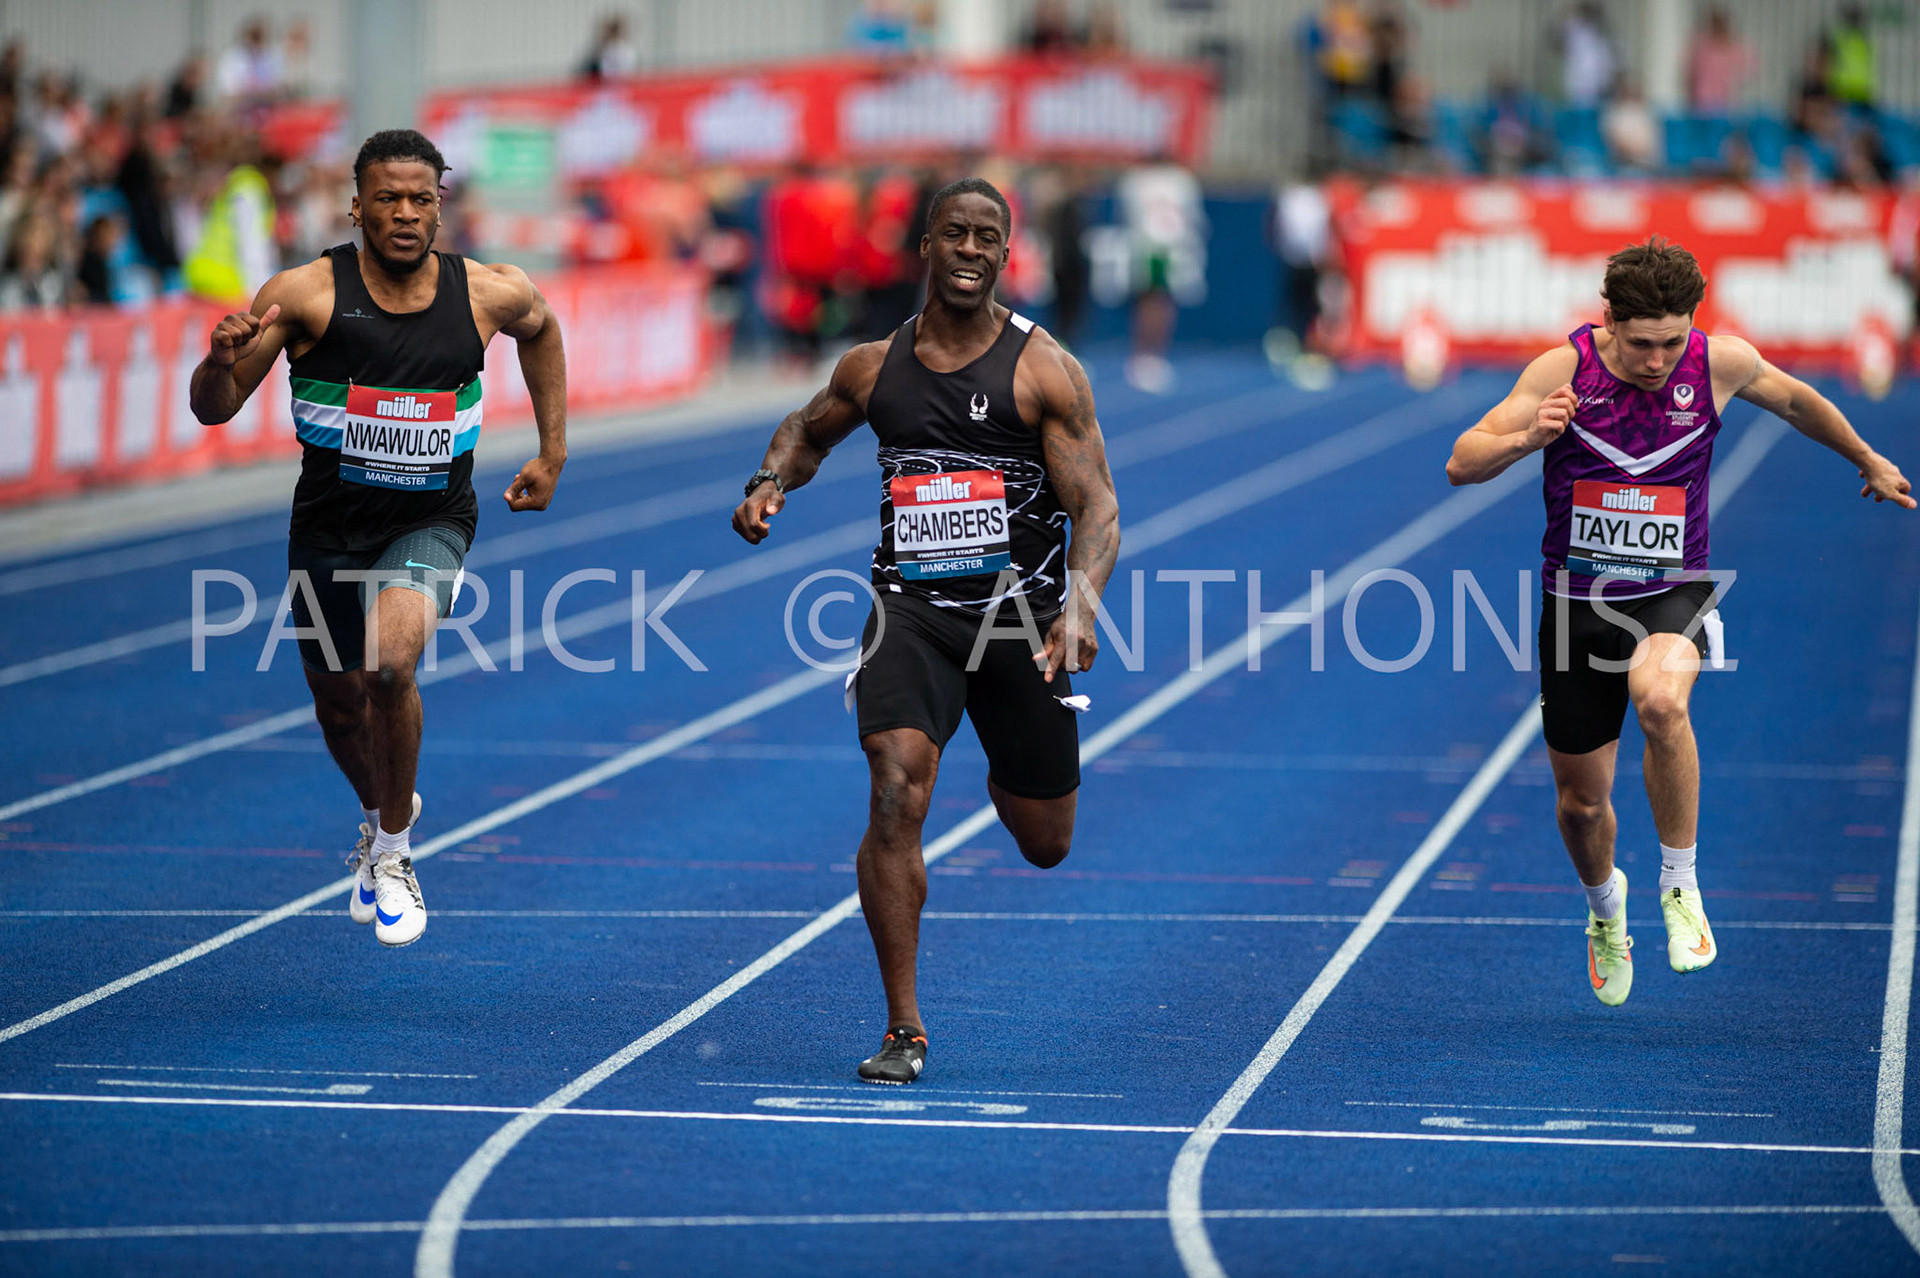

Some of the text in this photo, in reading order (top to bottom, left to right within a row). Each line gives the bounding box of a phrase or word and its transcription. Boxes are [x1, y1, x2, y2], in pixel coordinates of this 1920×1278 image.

[376, 396, 432, 419] müller
[345, 421, 451, 457] NWAWULOR
[365, 471, 427, 486] MANCHESTER
[915, 476, 972, 502] müller
[1601, 488, 1658, 512] müller
[898, 506, 1004, 543] CHAMBERS
[1575, 513, 1679, 551] TAYLOR
[920, 559, 984, 573] MANCHESTER
[1592, 563, 1655, 578] MANCHESTER
